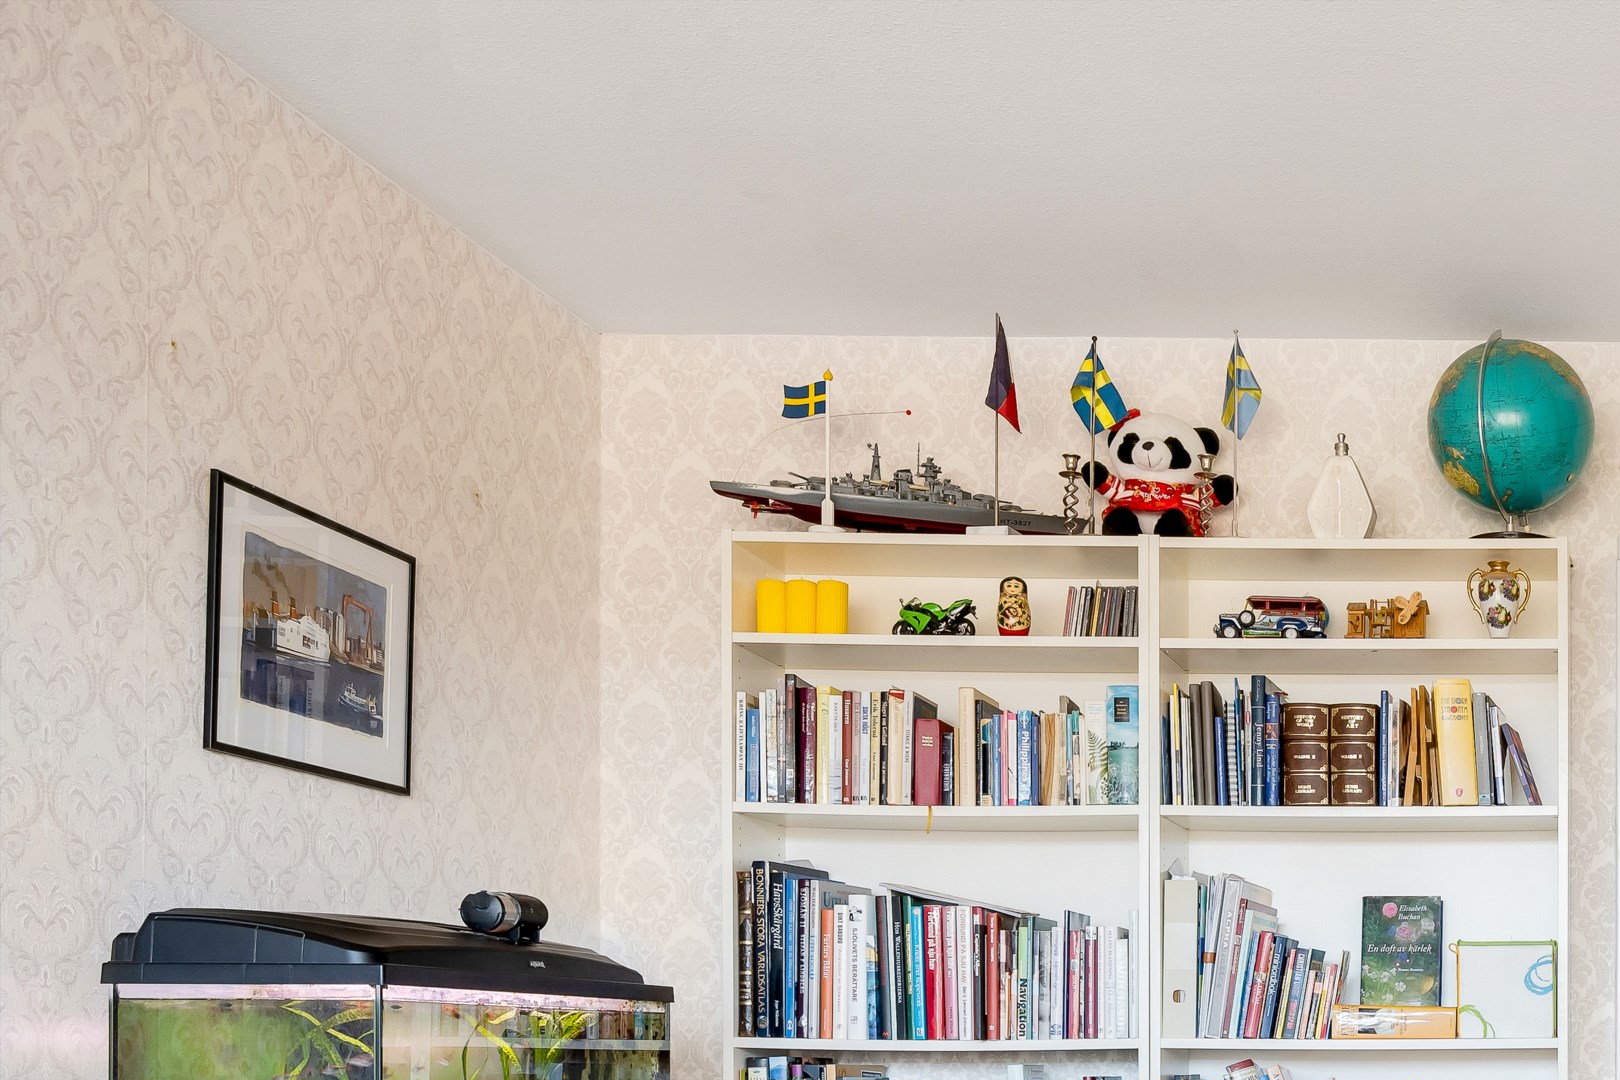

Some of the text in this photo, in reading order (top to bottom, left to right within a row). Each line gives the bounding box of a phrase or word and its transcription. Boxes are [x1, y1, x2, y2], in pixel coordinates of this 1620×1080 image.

[843, 699, 851, 725] Husaren
[1019, 731, 1031, 783] Philippines
[1254, 722, 1265, 768] Jenny Lind
[771, 883, 784, 950] HavsSkärgård
[799, 888, 808, 919] SJÖMÄN
[755, 867, 768, 1013] BONNIERS STORA VÄRLDSATLAS
[927, 911, 936, 971] Förbund på sju hav
[959, 909, 968, 943] FÖRBUND
[1221, 911, 1233, 949] ALPHA
[822, 933, 831, 979] Farfars Båtar
[851, 927, 859, 1003] SJÖLIVETS BERÄTTARE
[1293, 953, 1306, 983] CHRISTIAN
[1367, 944, 1379, 953] En
[1380, 944, 1396, 954] doft
[1408, 944, 1433, 954] kärlek
[914, 977, 922, 1008] Ropework
[1267, 953, 1281, 996] miniordbok
[1017, 978, 1028, 1037] Navigation
